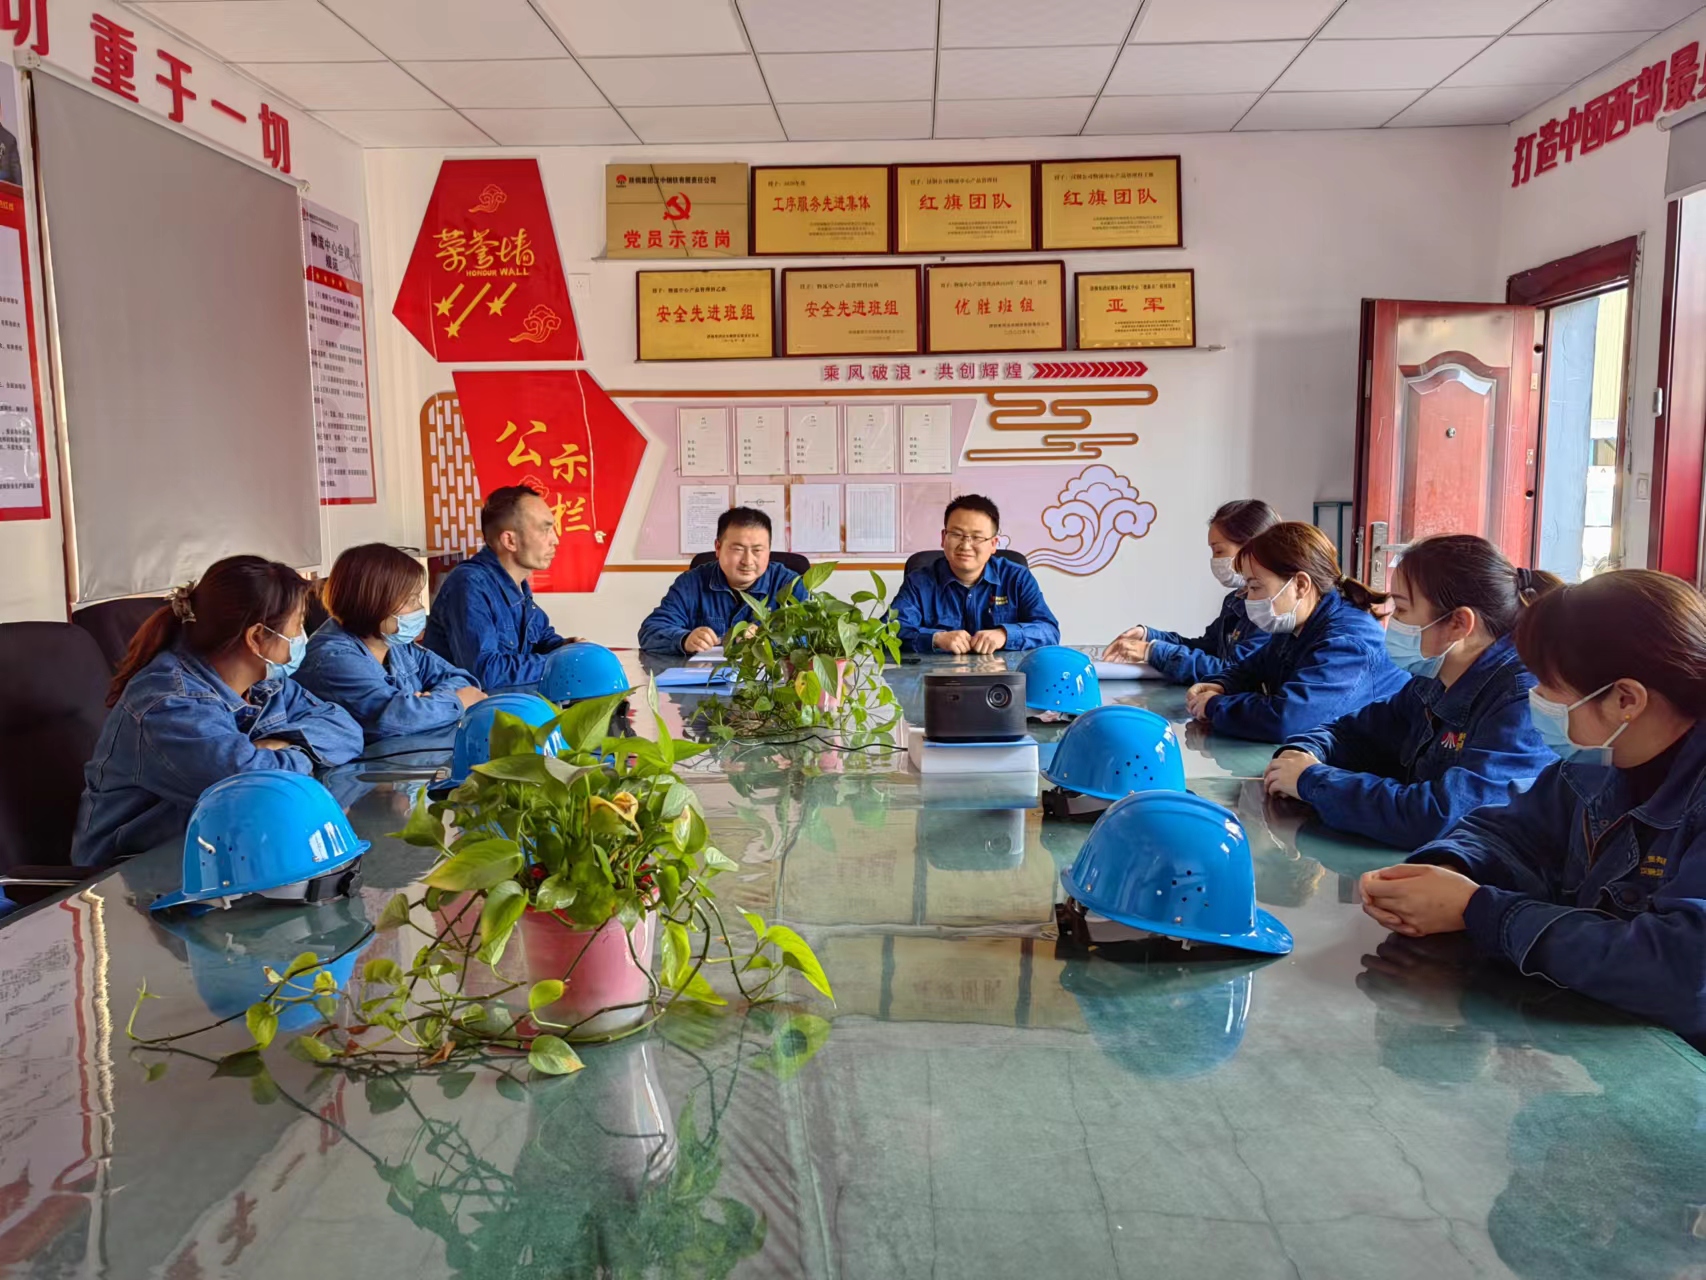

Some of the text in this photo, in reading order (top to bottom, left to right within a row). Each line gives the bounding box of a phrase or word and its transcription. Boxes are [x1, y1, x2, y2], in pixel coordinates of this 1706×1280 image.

[90, 13, 291, 174] 重于一切
[1511, 41, 1706, 187] 打造中国西部最
[772, 194, 871, 213] 工序服务先进集体
[919, 192, 1012, 211] 红旗团队
[1063, 187, 1158, 207] 红旗团队
[624, 229, 731, 249] 党员示范岗
[432, 227, 535, 273] 荣誉墙
[466, 267, 530, 277] HONOUR WALL
[656, 303, 756, 324] 安全先进班组
[804, 299, 900, 318] 安全先进班组
[954, 296, 1035, 316] 优胜班组
[1105, 296, 1165, 313] 亚军
